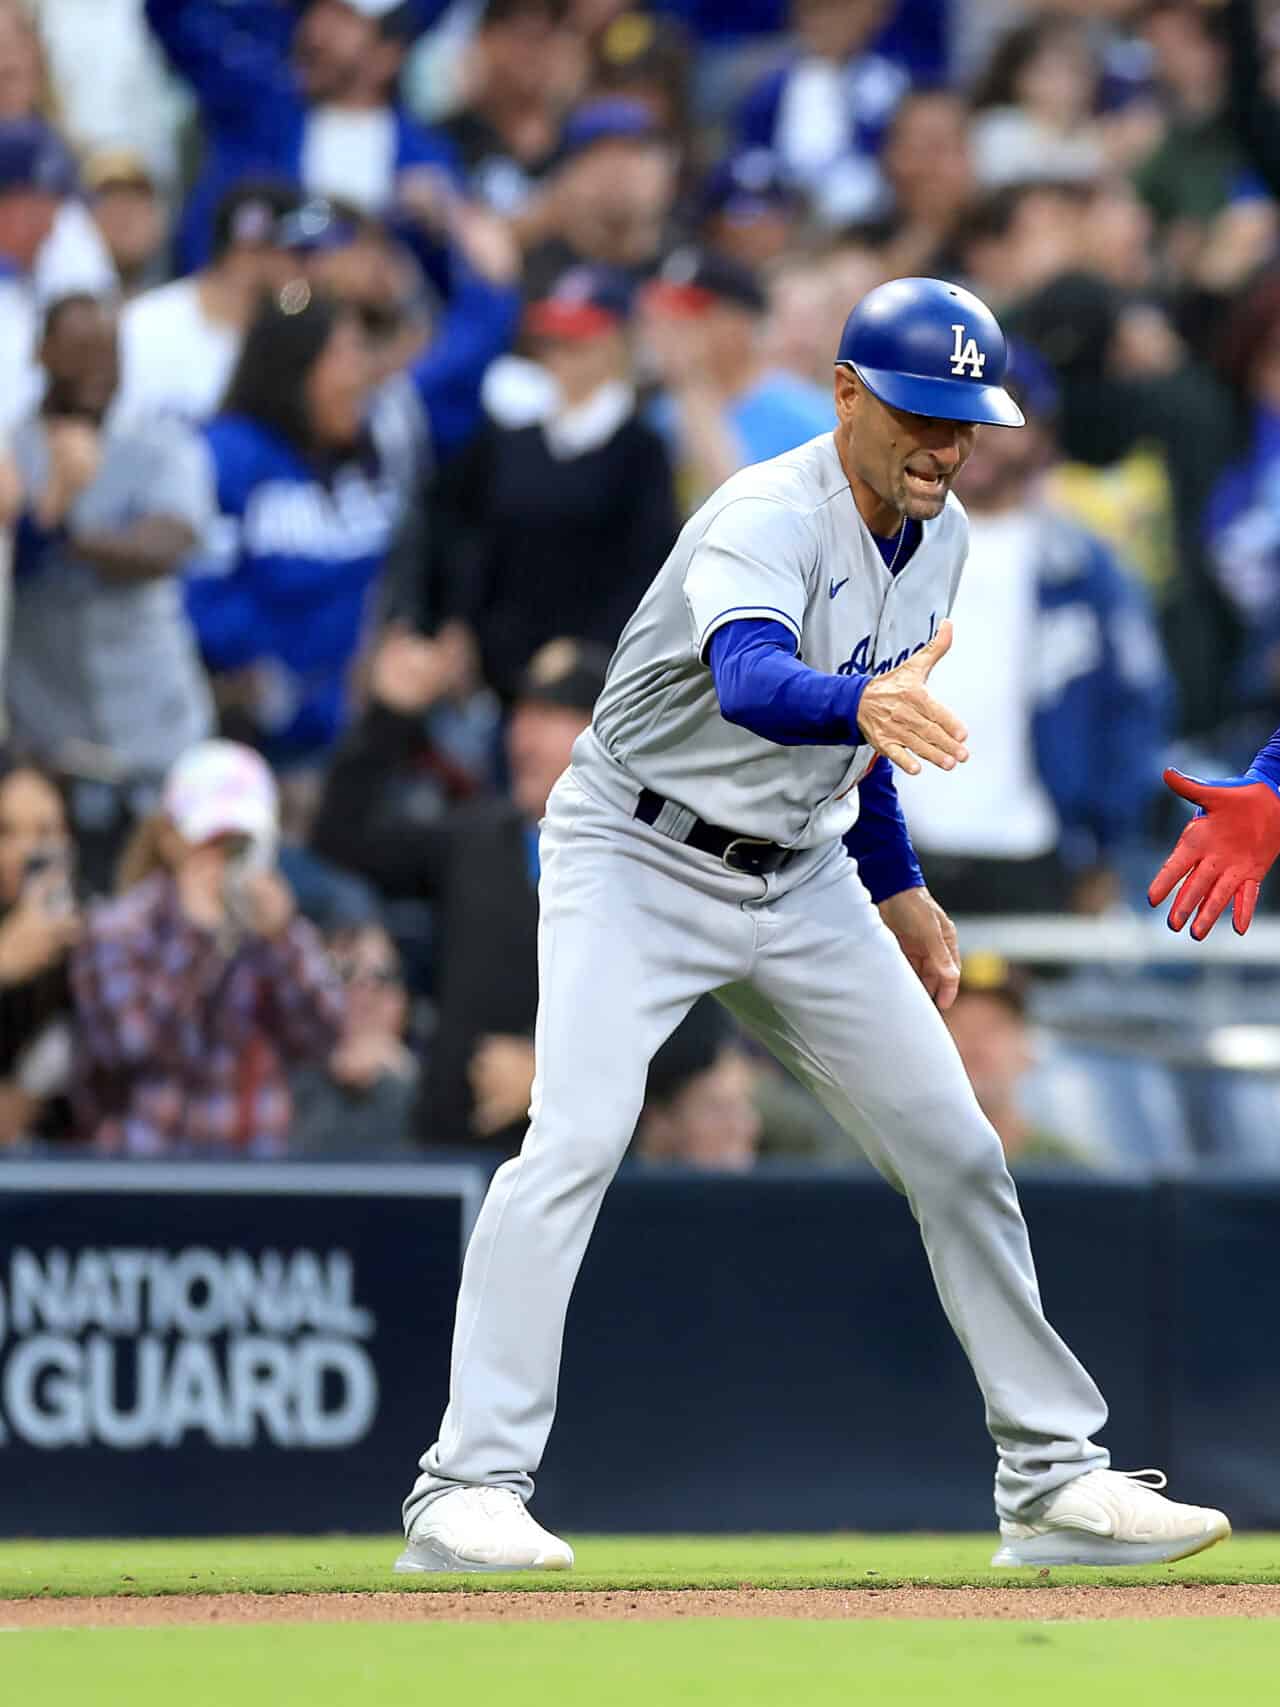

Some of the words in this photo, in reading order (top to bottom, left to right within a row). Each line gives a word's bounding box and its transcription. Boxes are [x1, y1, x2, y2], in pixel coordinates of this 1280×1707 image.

[949, 323, 986, 379] LA
[8, 1247, 376, 1339] NATIONAL
[2, 1336, 378, 1448] GUARD
